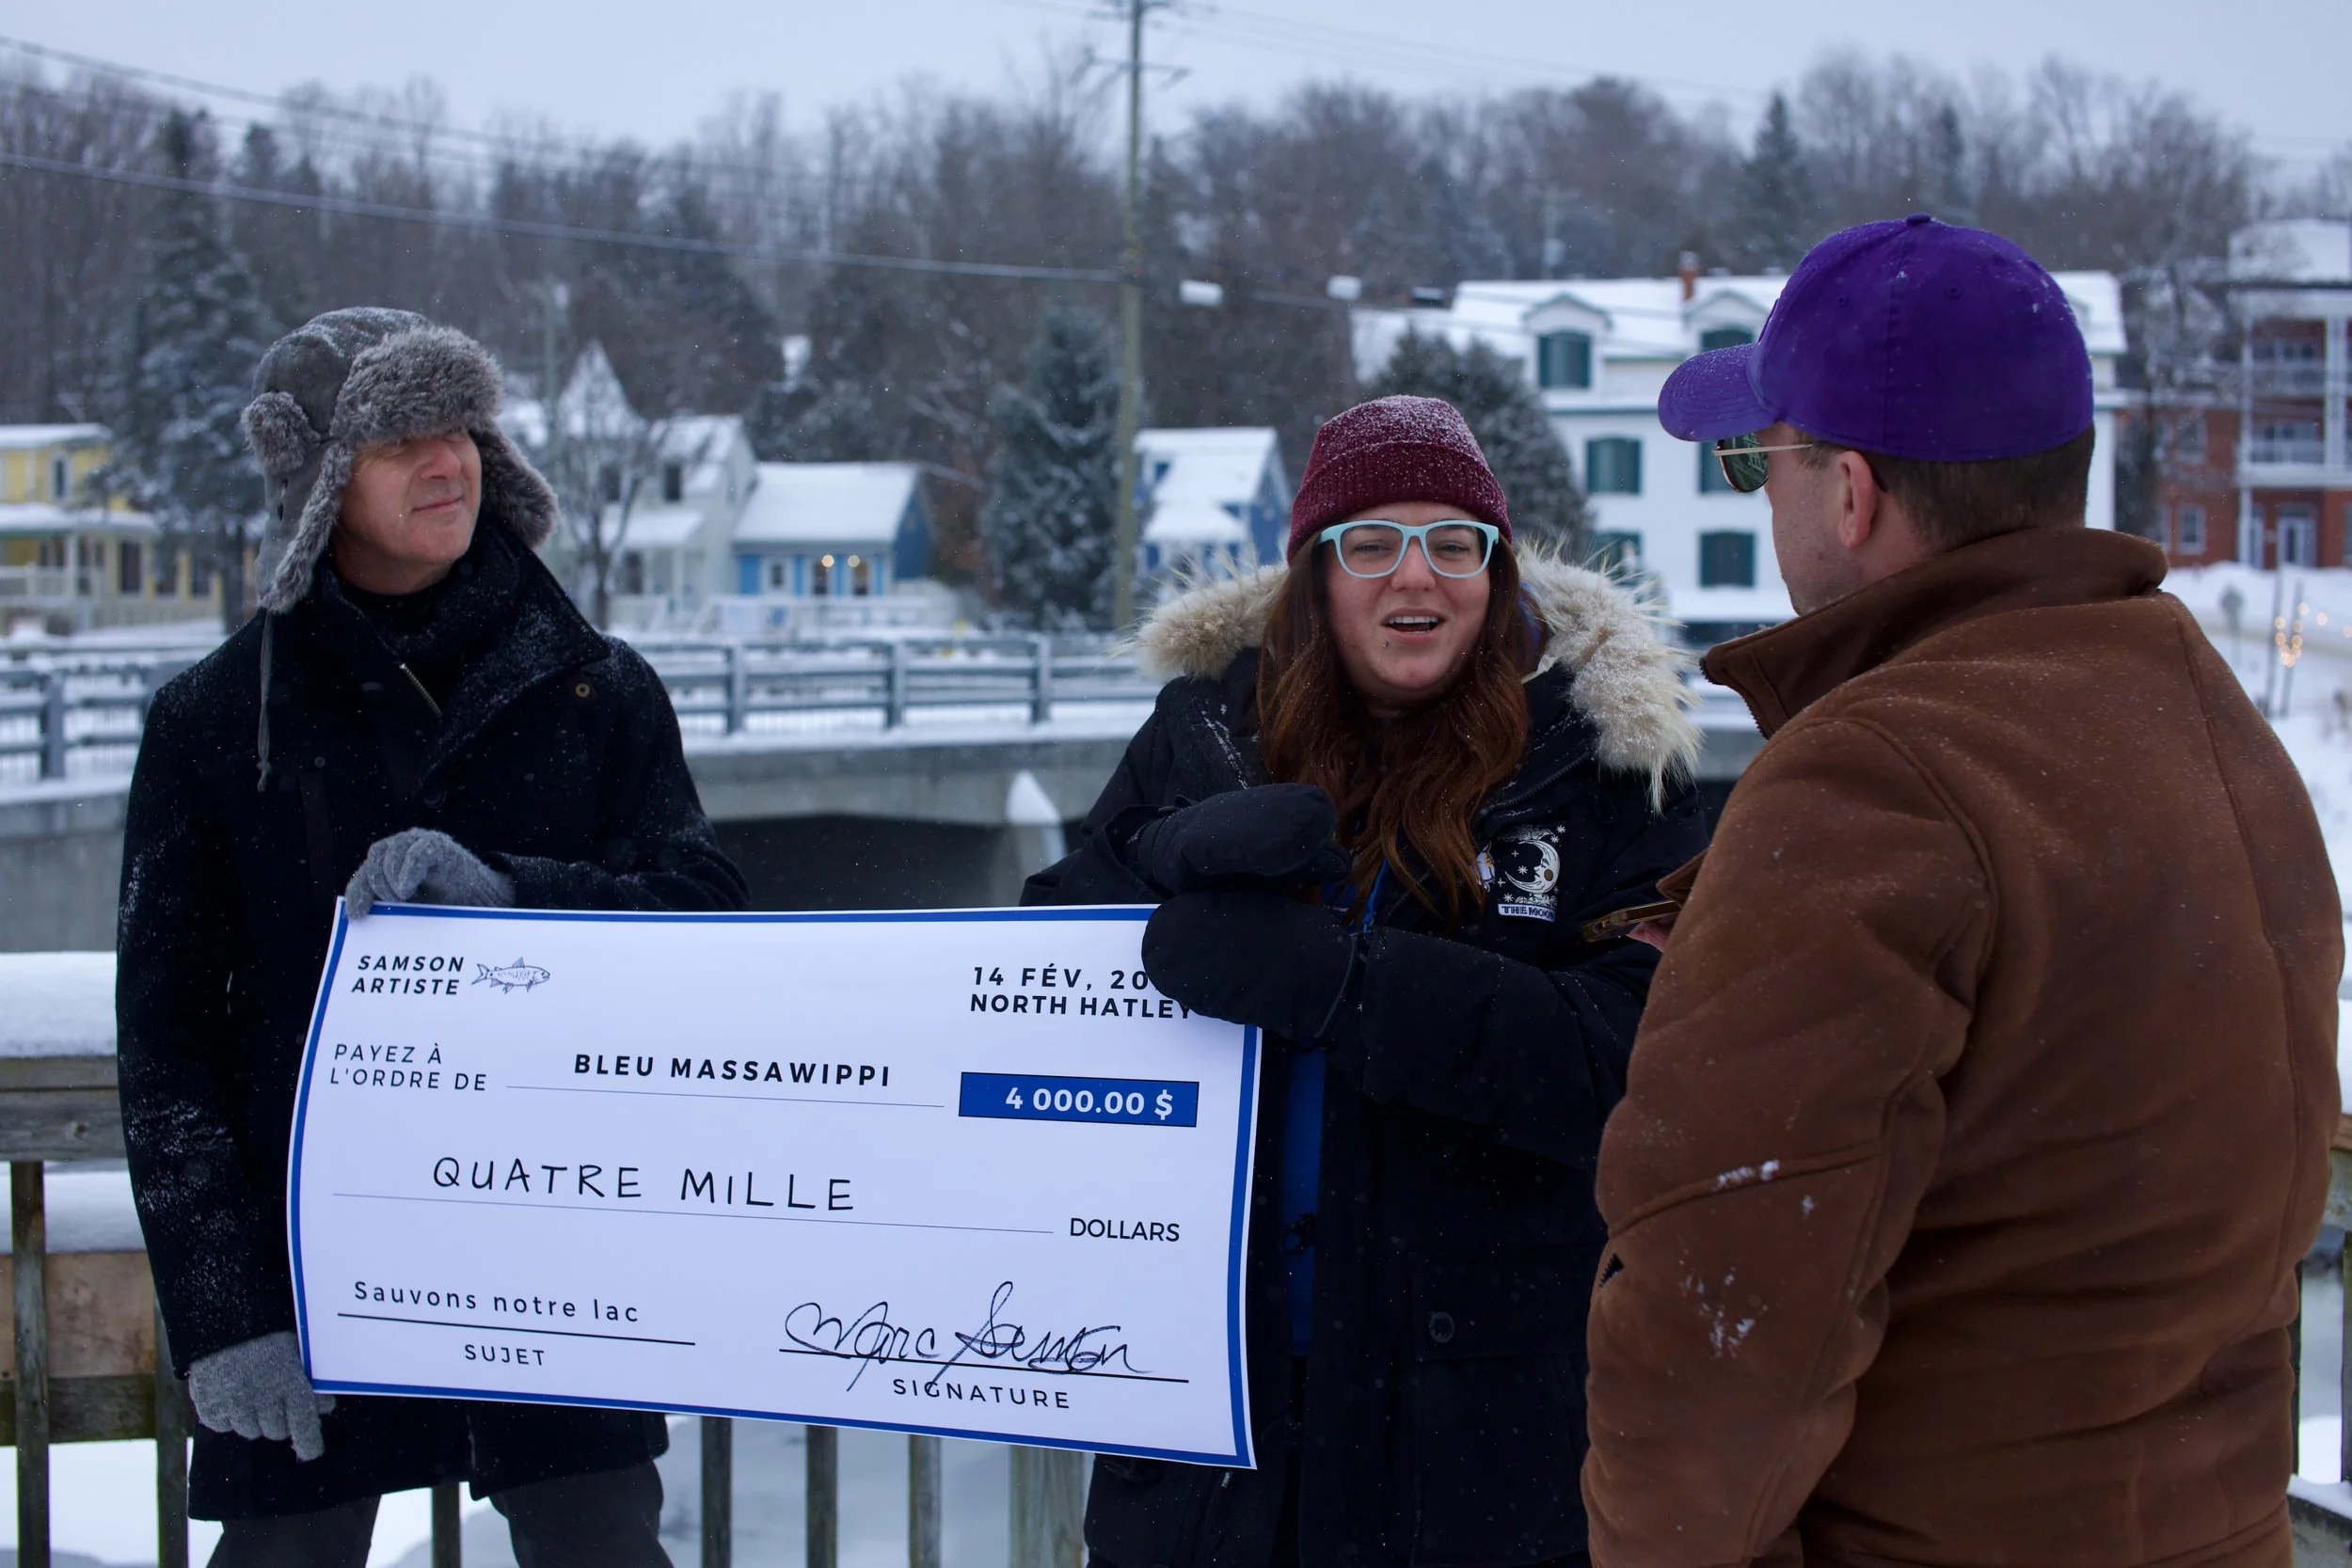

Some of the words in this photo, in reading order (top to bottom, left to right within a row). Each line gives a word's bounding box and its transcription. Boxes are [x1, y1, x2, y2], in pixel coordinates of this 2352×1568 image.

[1501, 905, 1528, 915] THE
[358, 955, 465, 973] SAMSON
[973, 966, 1004, 987] 14
[1021, 962, 1093, 991] FÉV,
[351, 977, 460, 995] ARTISTE
[970, 993, 1068, 1015] NORTH
[1080, 996, 1191, 1020] HATLEY
[334, 1043, 416, 1064] PAYEZ
[427, 1041, 443, 1065] À
[330, 1068, 441, 1090] L'ORDRE
[454, 1072, 487, 1091] DE
[574, 1053, 654, 1078] BLEU
[670, 1057, 890, 1087] MASSAWIPPI
[1005, 1087, 1024, 1110] 4
[1032, 1088, 1146, 1116] 000.00
[1153, 1089, 1174, 1121] $
[432, 1156, 643, 1199] QUATRE
[680, 1167, 854, 1212] MILLE
[1069, 1217, 1181, 1243] DOLLARS
[354, 1281, 477, 1309] Sauvons
[493, 1295, 577, 1318] notre
[594, 1298, 639, 1323] lac
[464, 1343, 546, 1366] SUJET
[892, 1377, 1071, 1410] SIGNATURE
